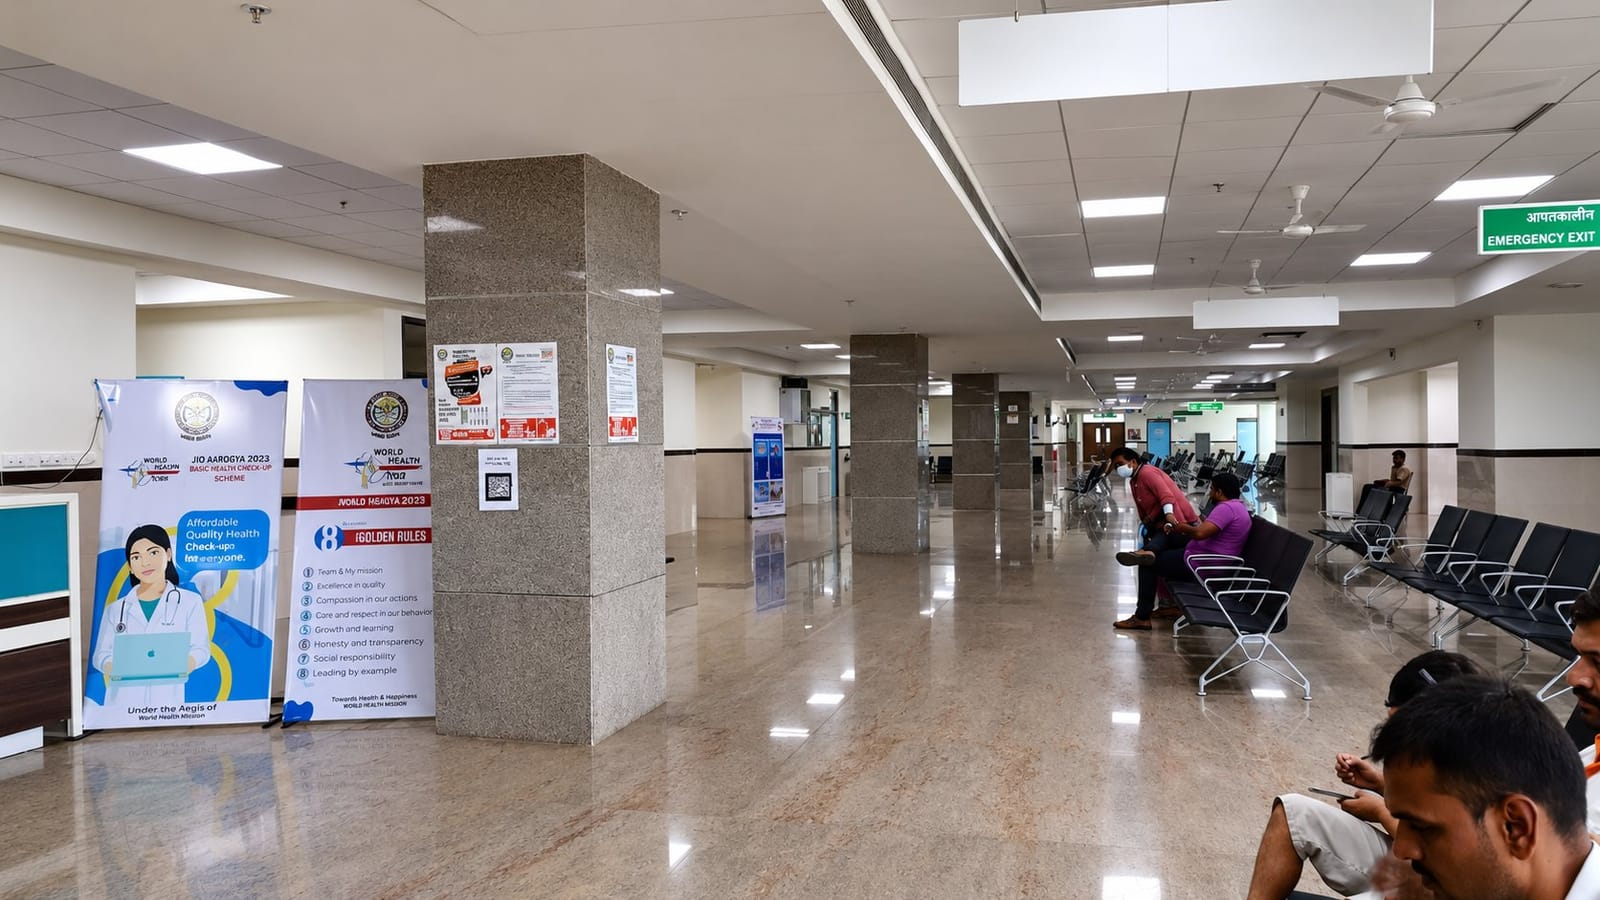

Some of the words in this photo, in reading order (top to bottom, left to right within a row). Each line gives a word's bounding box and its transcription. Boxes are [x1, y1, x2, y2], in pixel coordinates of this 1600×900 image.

[1488, 232, 1565, 246] EMERGENCY
[1568, 231, 1596, 243] EXIT
[206, 455, 246, 463] AAROGYA
[248, 455, 270, 463] 2023
[401, 496, 425, 505] 2023
[186, 518, 238, 527] Affordable
[186, 530, 223, 540] Quality
[226, 529, 260, 538] Health
[321, 525, 338, 551] 8
[397, 530, 426, 542] RULES
[316, 596, 363, 605] Compassion
[350, 610, 378, 620] respect
[315, 625, 344, 634] Growth
[362, 624, 394, 633] learning
[314, 640, 349, 649] Honesty
[369, 638, 424, 647] transparency
[313, 654, 338, 662] Social
[340, 653, 396, 662] responsibility
[313, 668, 346, 678] Leading
[348, 667, 359, 677] by
[361, 666, 398, 676] example
[160, 705, 176, 713] the
[179, 704, 205, 714] Aegis
